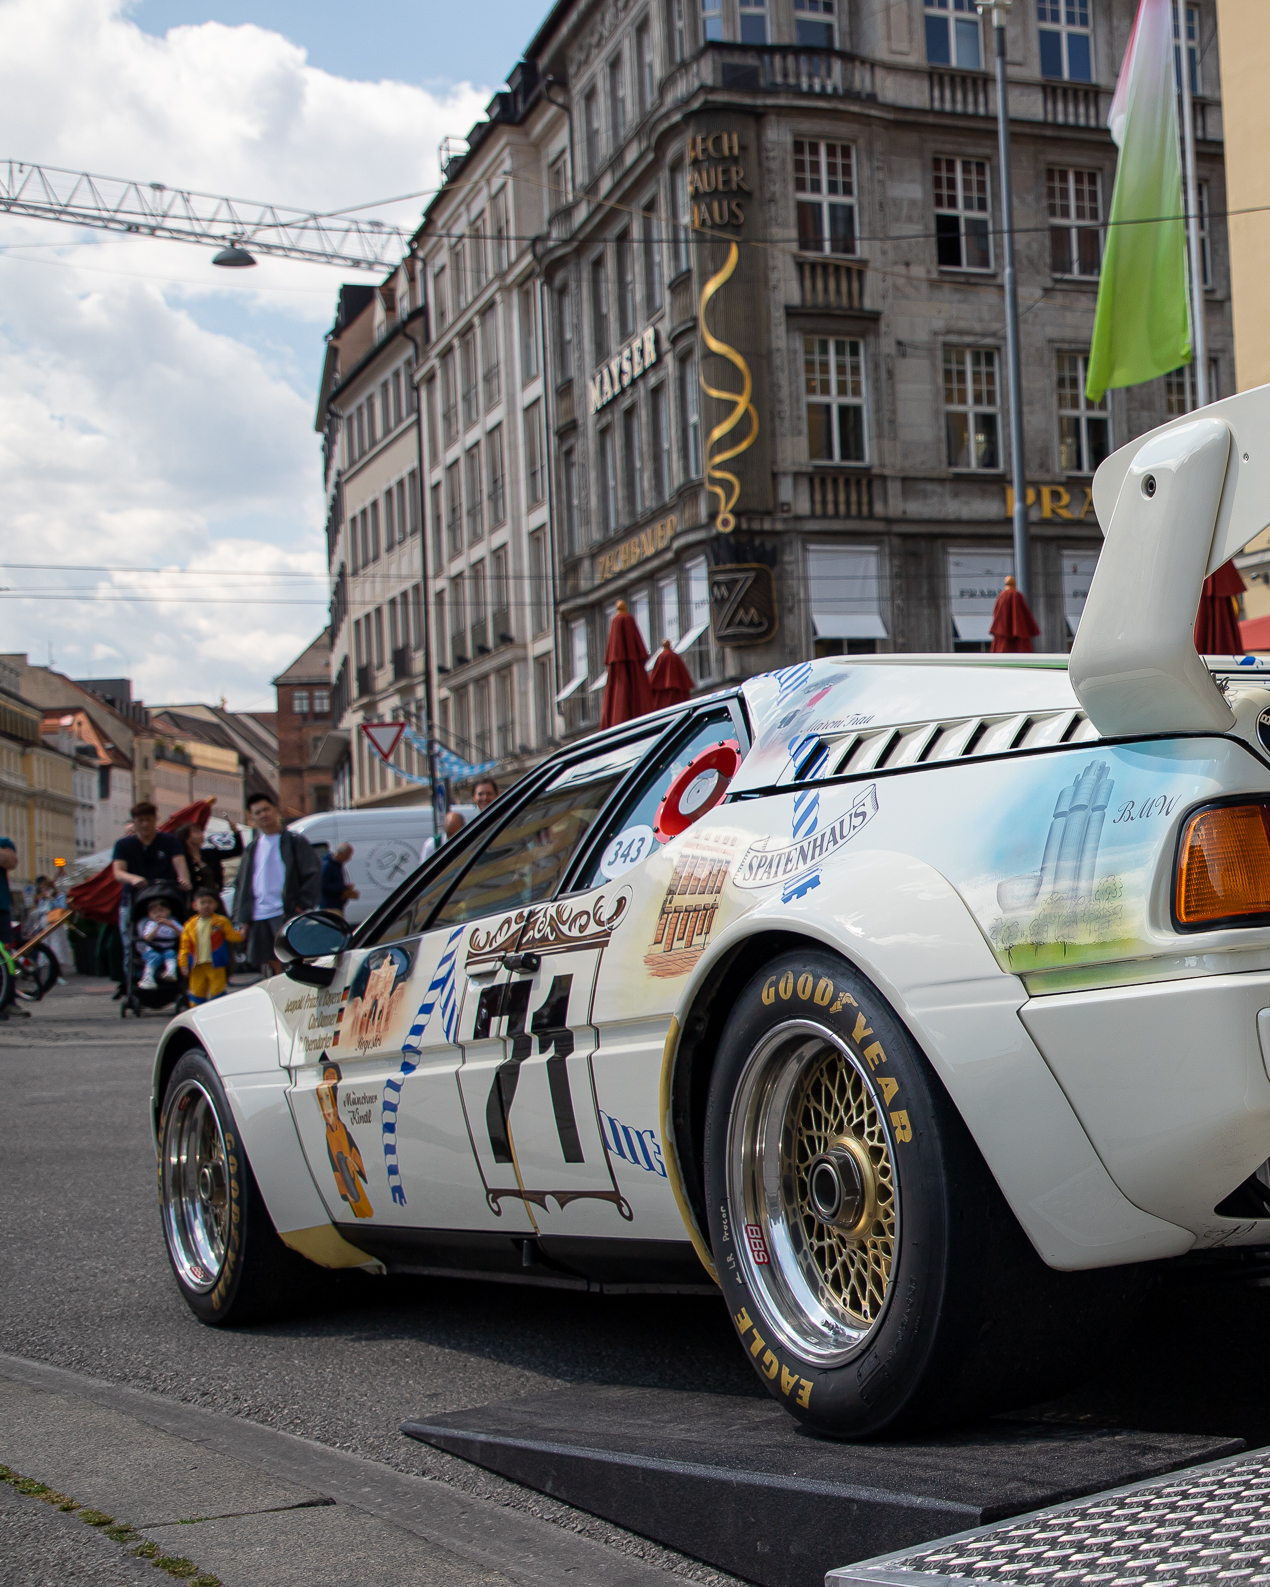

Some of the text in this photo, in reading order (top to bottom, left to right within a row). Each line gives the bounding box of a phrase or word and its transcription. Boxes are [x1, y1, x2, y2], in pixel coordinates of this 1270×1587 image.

[1112, 794, 1182, 824] BMW
[607, 837, 646, 867] 343
[742, 803, 869, 881] SPATENHAUS
[473, 974, 585, 1164] 71
[746, 1225, 769, 1264] BBS
[734, 1307, 814, 1409] EAGLE
